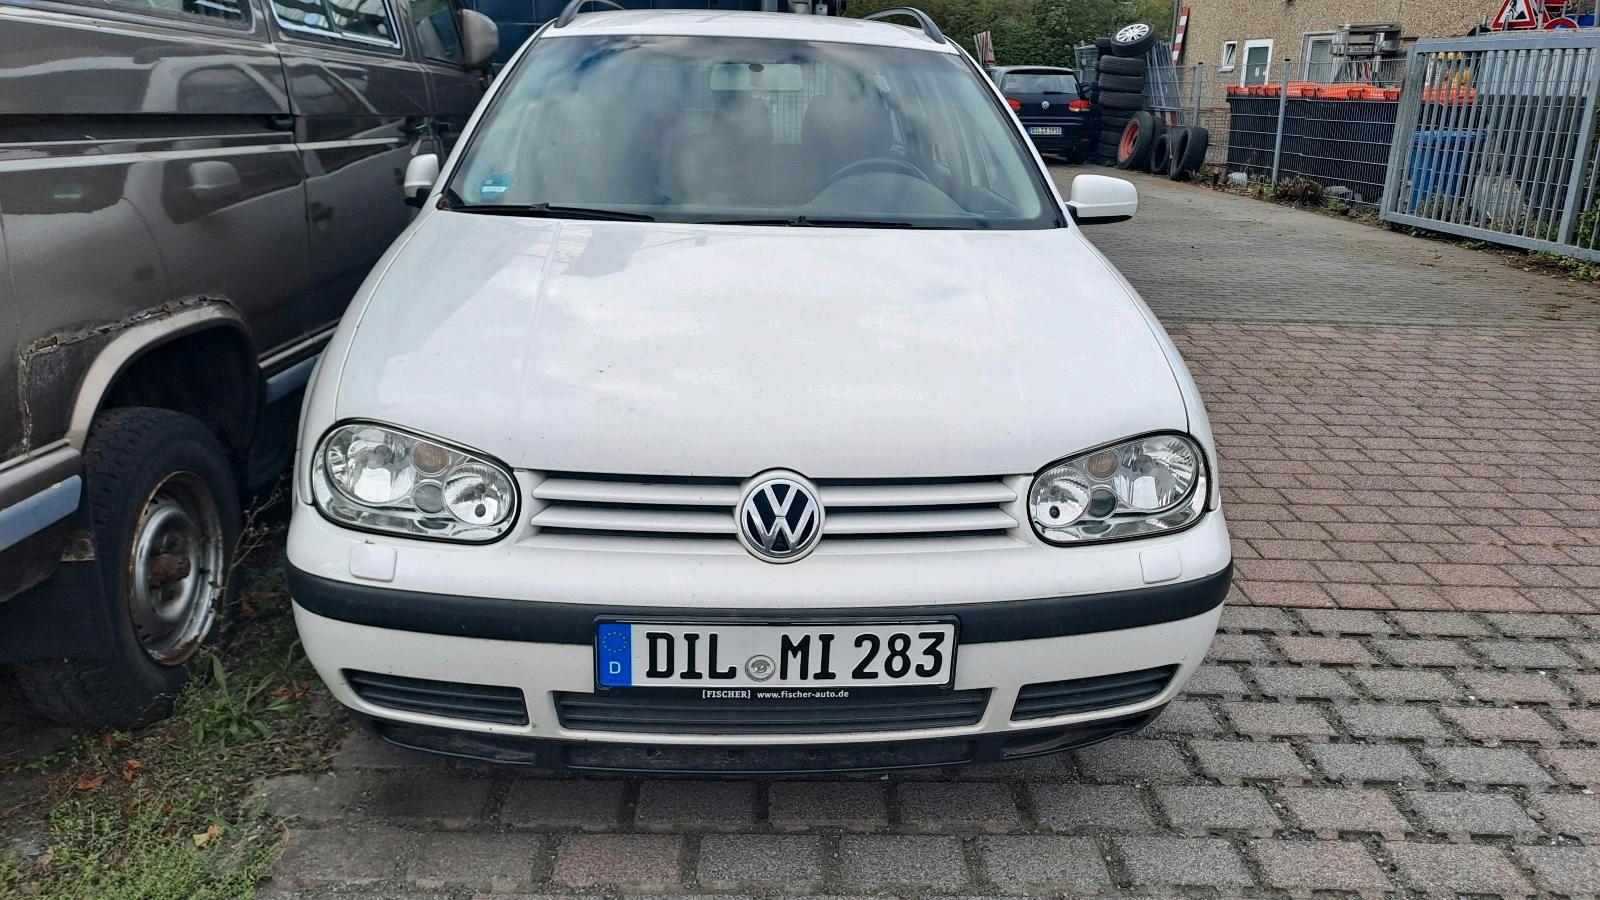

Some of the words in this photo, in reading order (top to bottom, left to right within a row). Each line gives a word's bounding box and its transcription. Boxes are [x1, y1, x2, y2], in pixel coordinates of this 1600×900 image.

[645, 631, 738, 680] DIL
[780, 633, 837, 680] MI
[851, 631, 946, 679] 283
[609, 661, 621, 674] D
[702, 689, 751, 699] [FISCHER]
[757, 689, 850, 699] www.fischer-auto.de
